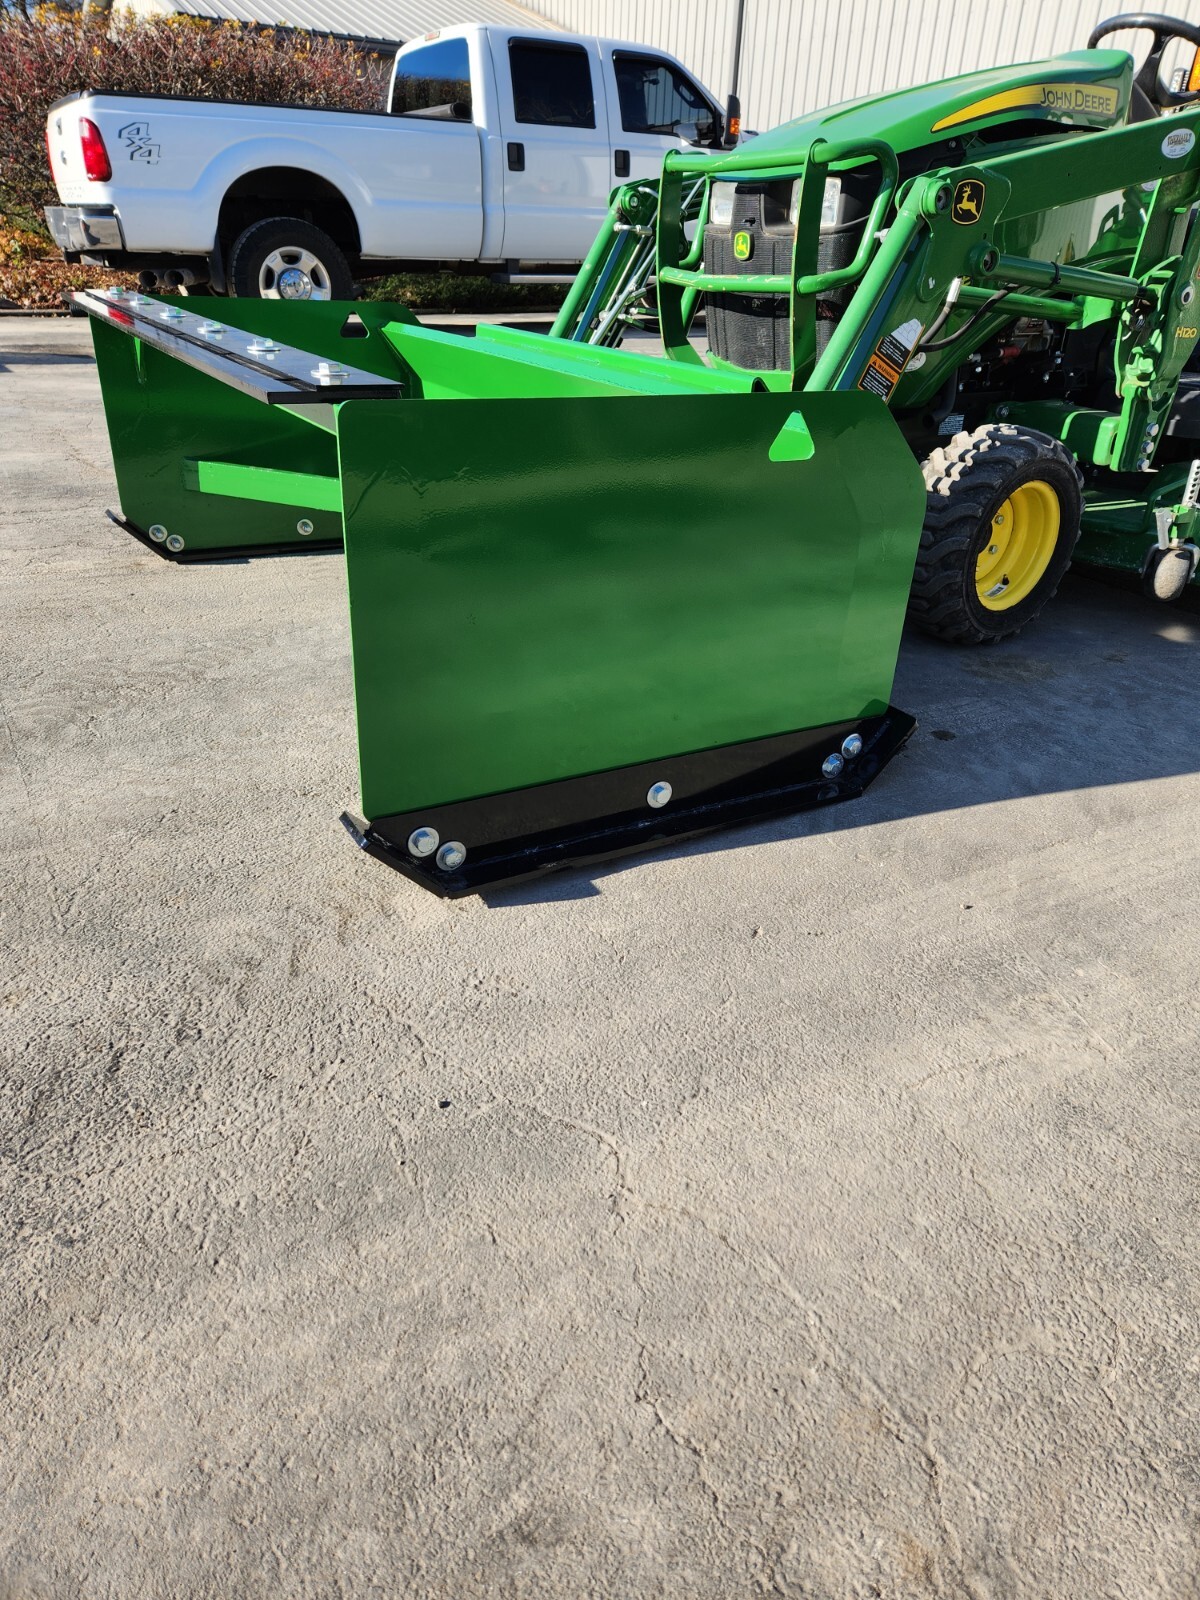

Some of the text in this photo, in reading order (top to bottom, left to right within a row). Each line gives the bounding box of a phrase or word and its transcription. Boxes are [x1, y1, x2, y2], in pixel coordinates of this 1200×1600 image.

[1040, 87, 1112, 112] JOHN DEERE
[1175, 326, 1198, 338] H120
[877, 362, 896, 381] WARNING
